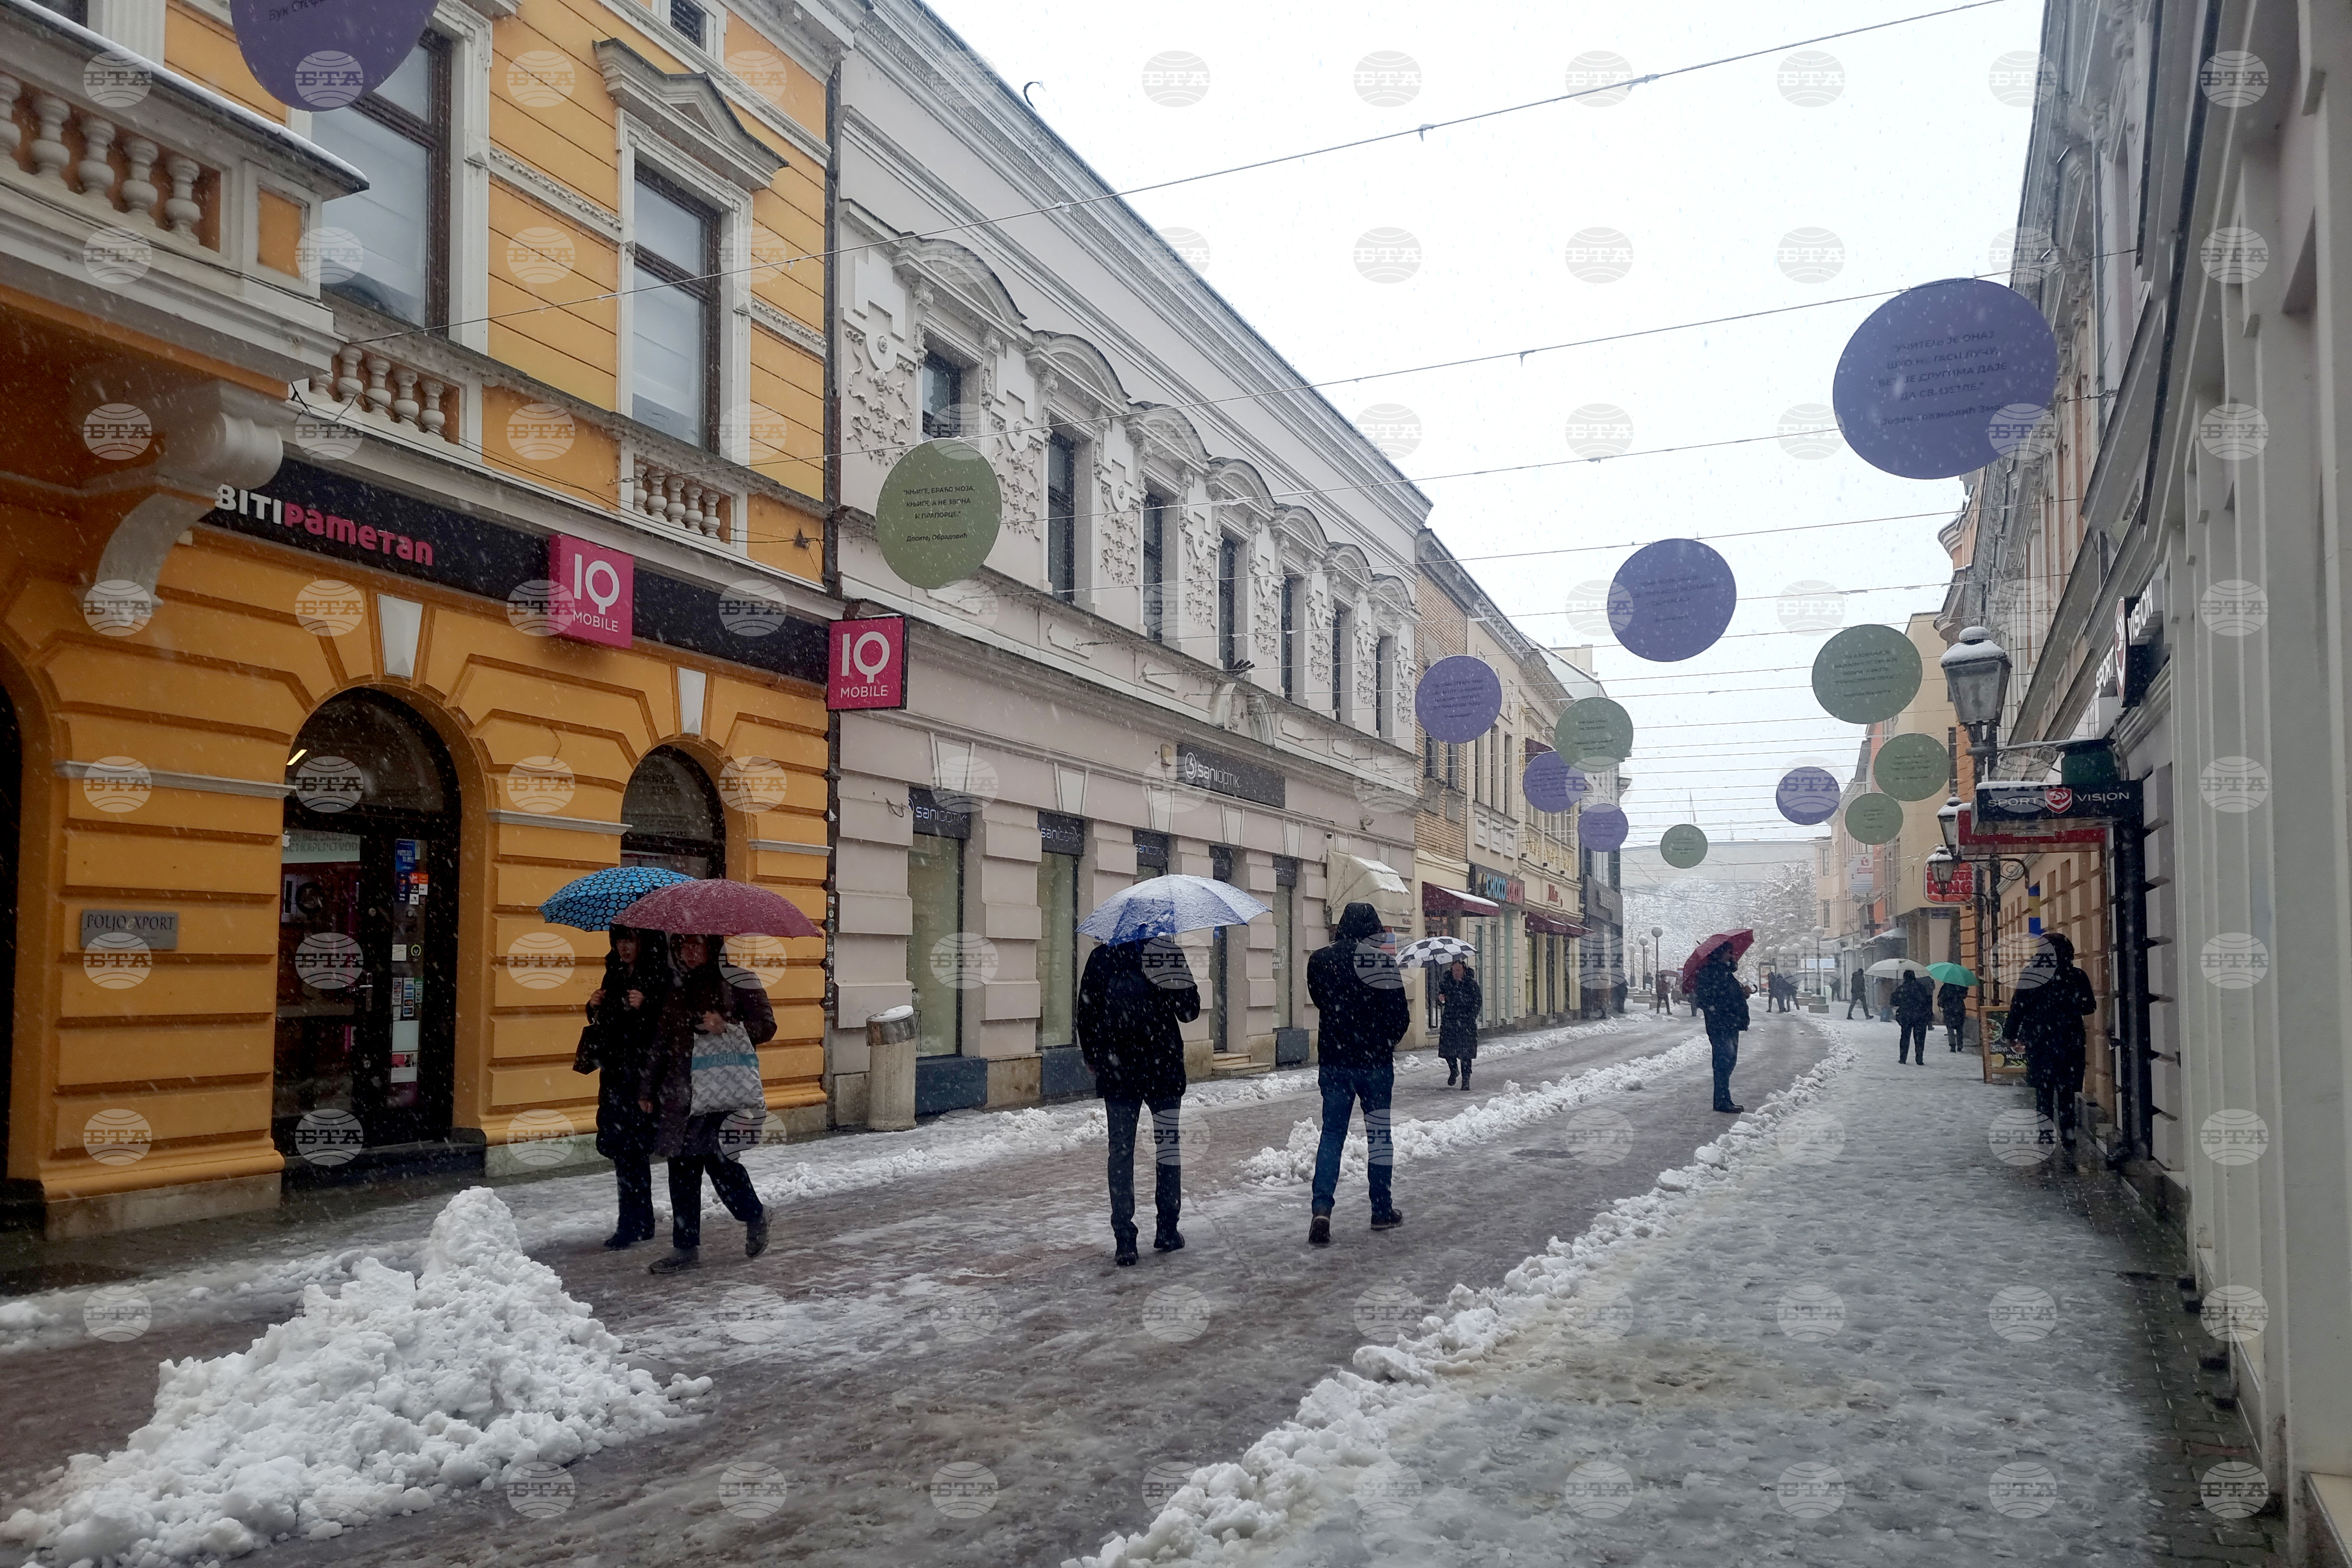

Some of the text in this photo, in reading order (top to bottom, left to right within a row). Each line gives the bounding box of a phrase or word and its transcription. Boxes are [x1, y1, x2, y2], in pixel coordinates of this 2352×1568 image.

[1963, 330, 1994, 342] ОНАЈ
[1934, 352, 1962, 363] ГАСИ
[1919, 367, 1974, 382] ДРУГИМА
[1977, 362, 2008, 375] ДАЈЕ
[1900, 391, 1916, 401] ДА
[932, 533, 967, 541] Обрадовић
[574, 554, 620, 615] IQ
[573, 610, 619, 633] MOBILE
[841, 631, 890, 684] IQ
[840, 684, 888, 698] MOBILE
[1988, 792, 2130, 807] SPORT VISION
[1927, 871, 1973, 881] BGER
[1927, 880, 1973, 894] KNG
